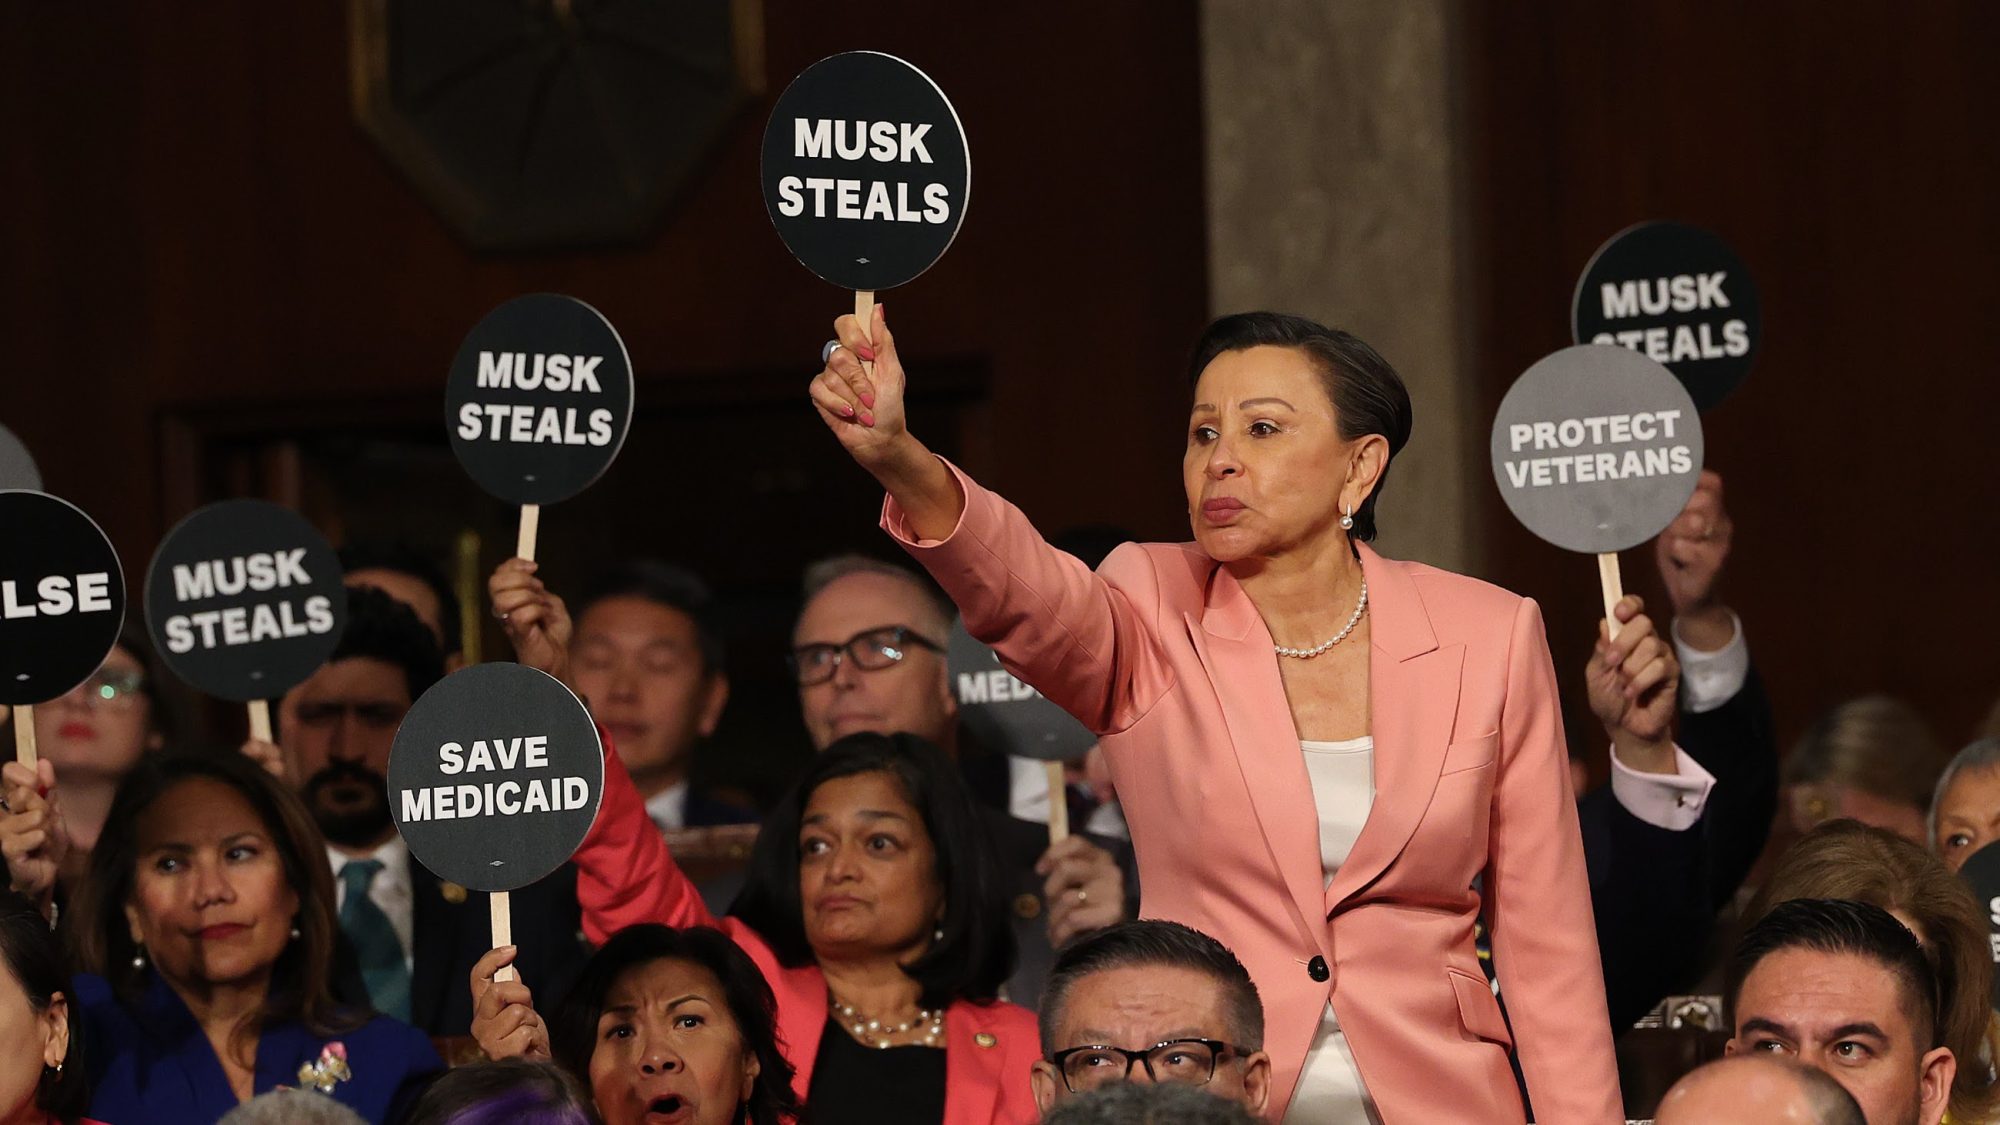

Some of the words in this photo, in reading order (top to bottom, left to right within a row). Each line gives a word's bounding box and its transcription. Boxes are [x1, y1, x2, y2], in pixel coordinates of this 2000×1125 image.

[794, 117, 934, 164] MUSK
[777, 175, 950, 225] STEALS
[1600, 271, 1731, 320] MUSK
[476, 351, 604, 393] MUSK
[457, 402, 613, 447] STEALS
[1509, 409, 1681, 452] PROTECT
[1504, 445, 1693, 489] VETERANS
[0, 572, 112, 620] LSE
[172, 548, 312, 602] MUSK
[165, 595, 334, 654] STEALS
[438, 735, 549, 775] SAVE
[400, 776, 590, 823] MEDICAID
